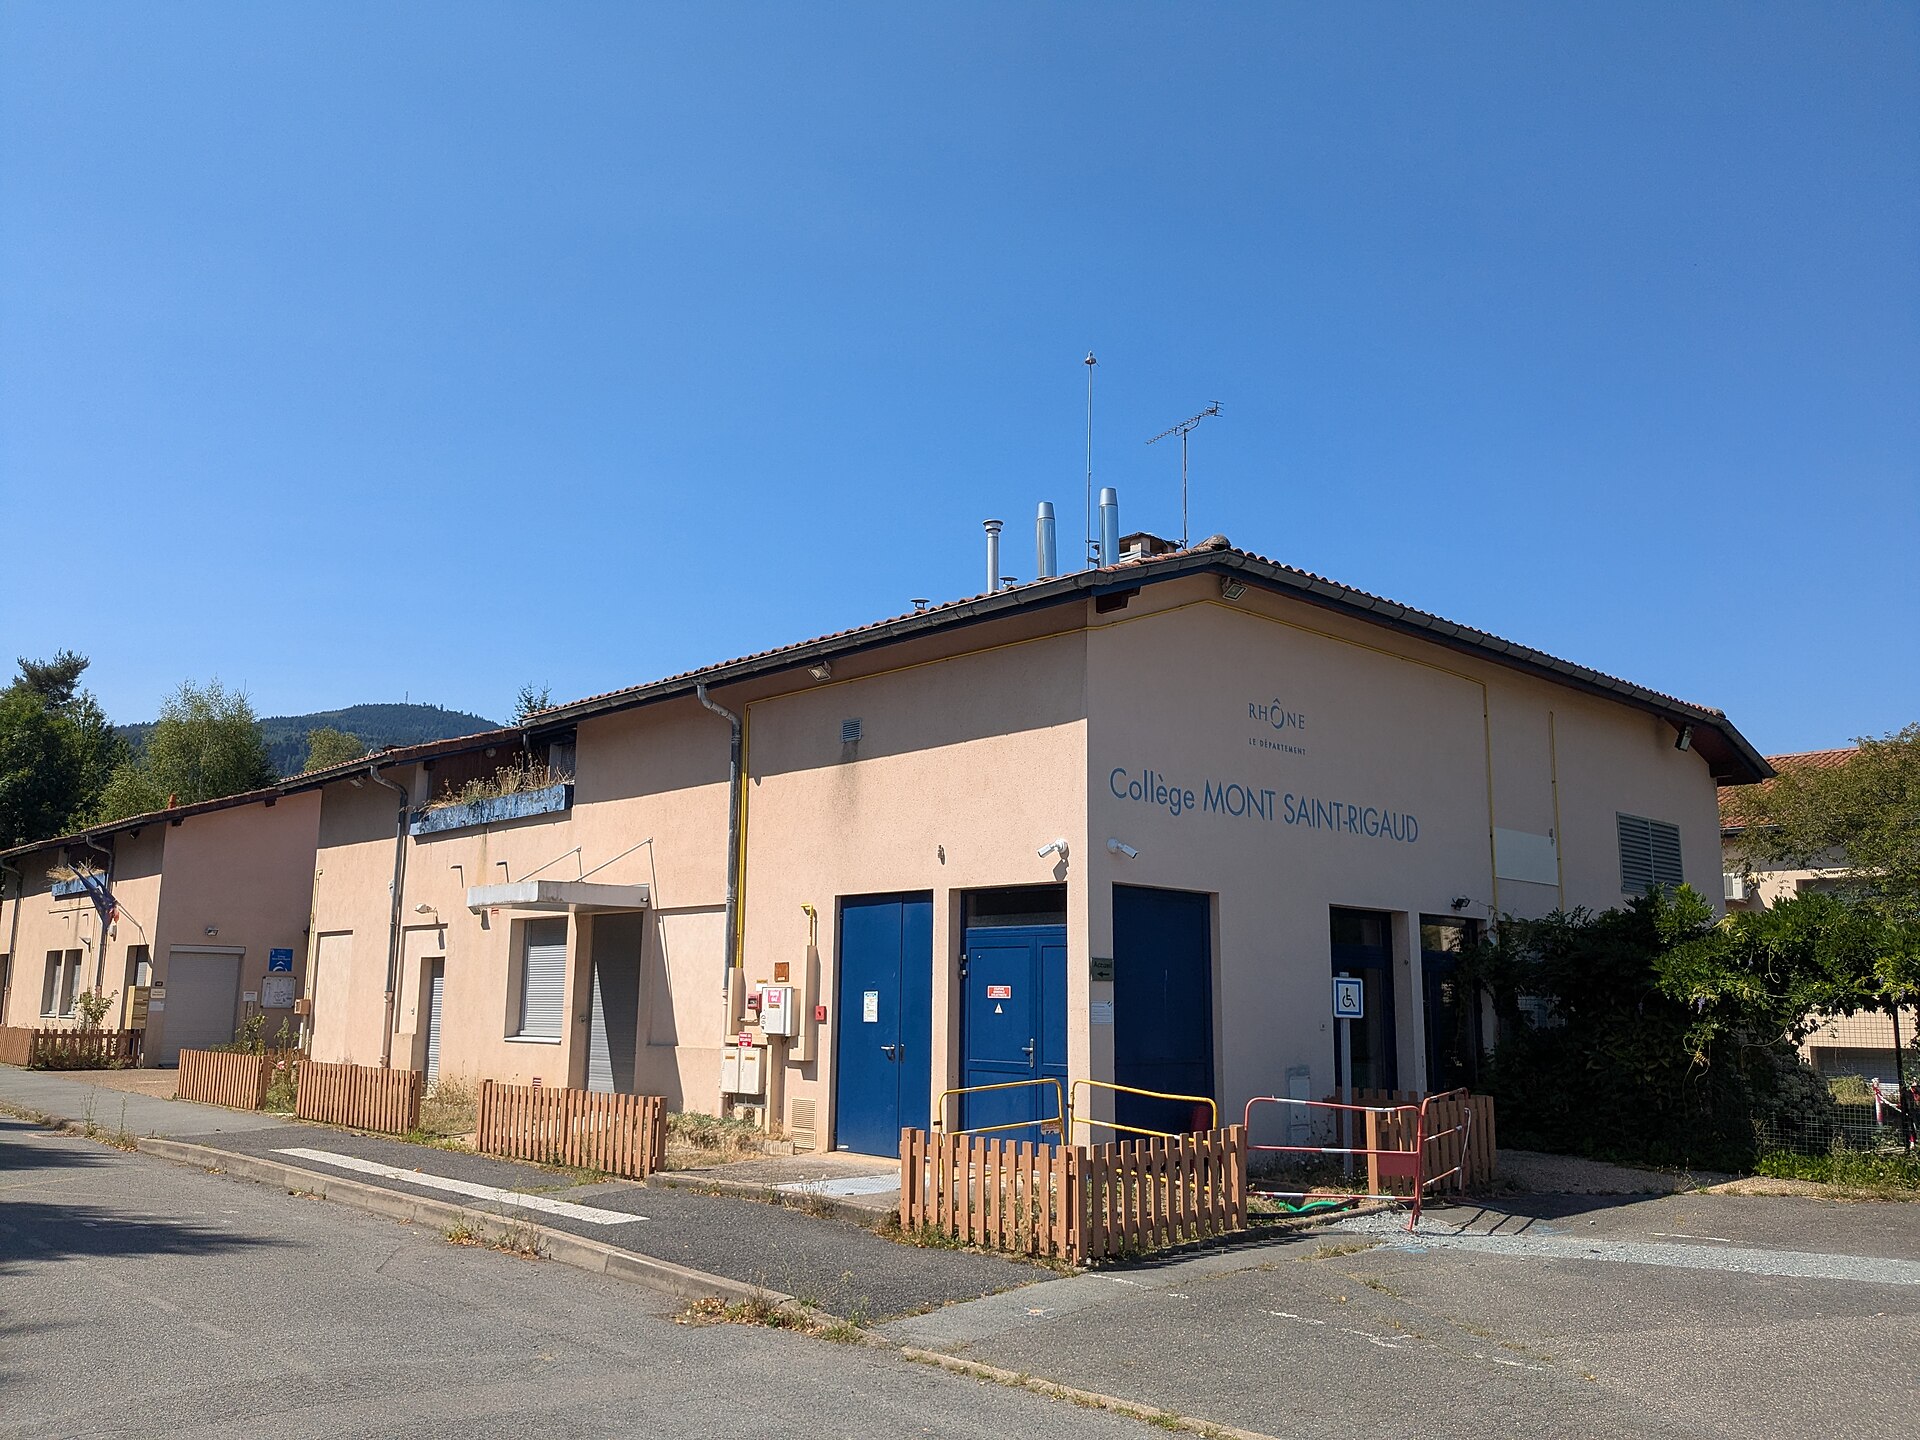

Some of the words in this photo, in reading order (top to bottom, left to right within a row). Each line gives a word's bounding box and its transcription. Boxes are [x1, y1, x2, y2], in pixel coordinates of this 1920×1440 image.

[1248, 697, 1305, 729] RHÔNE
[1248, 737, 1257, 746] LE
[1260, 739, 1306, 755] DÉPARTEMENT
[1110, 768, 1195, 816] Collège
[1203, 779, 1276, 821] MONT
[1284, 793, 1418, 843] SAINT-RIGAUD
